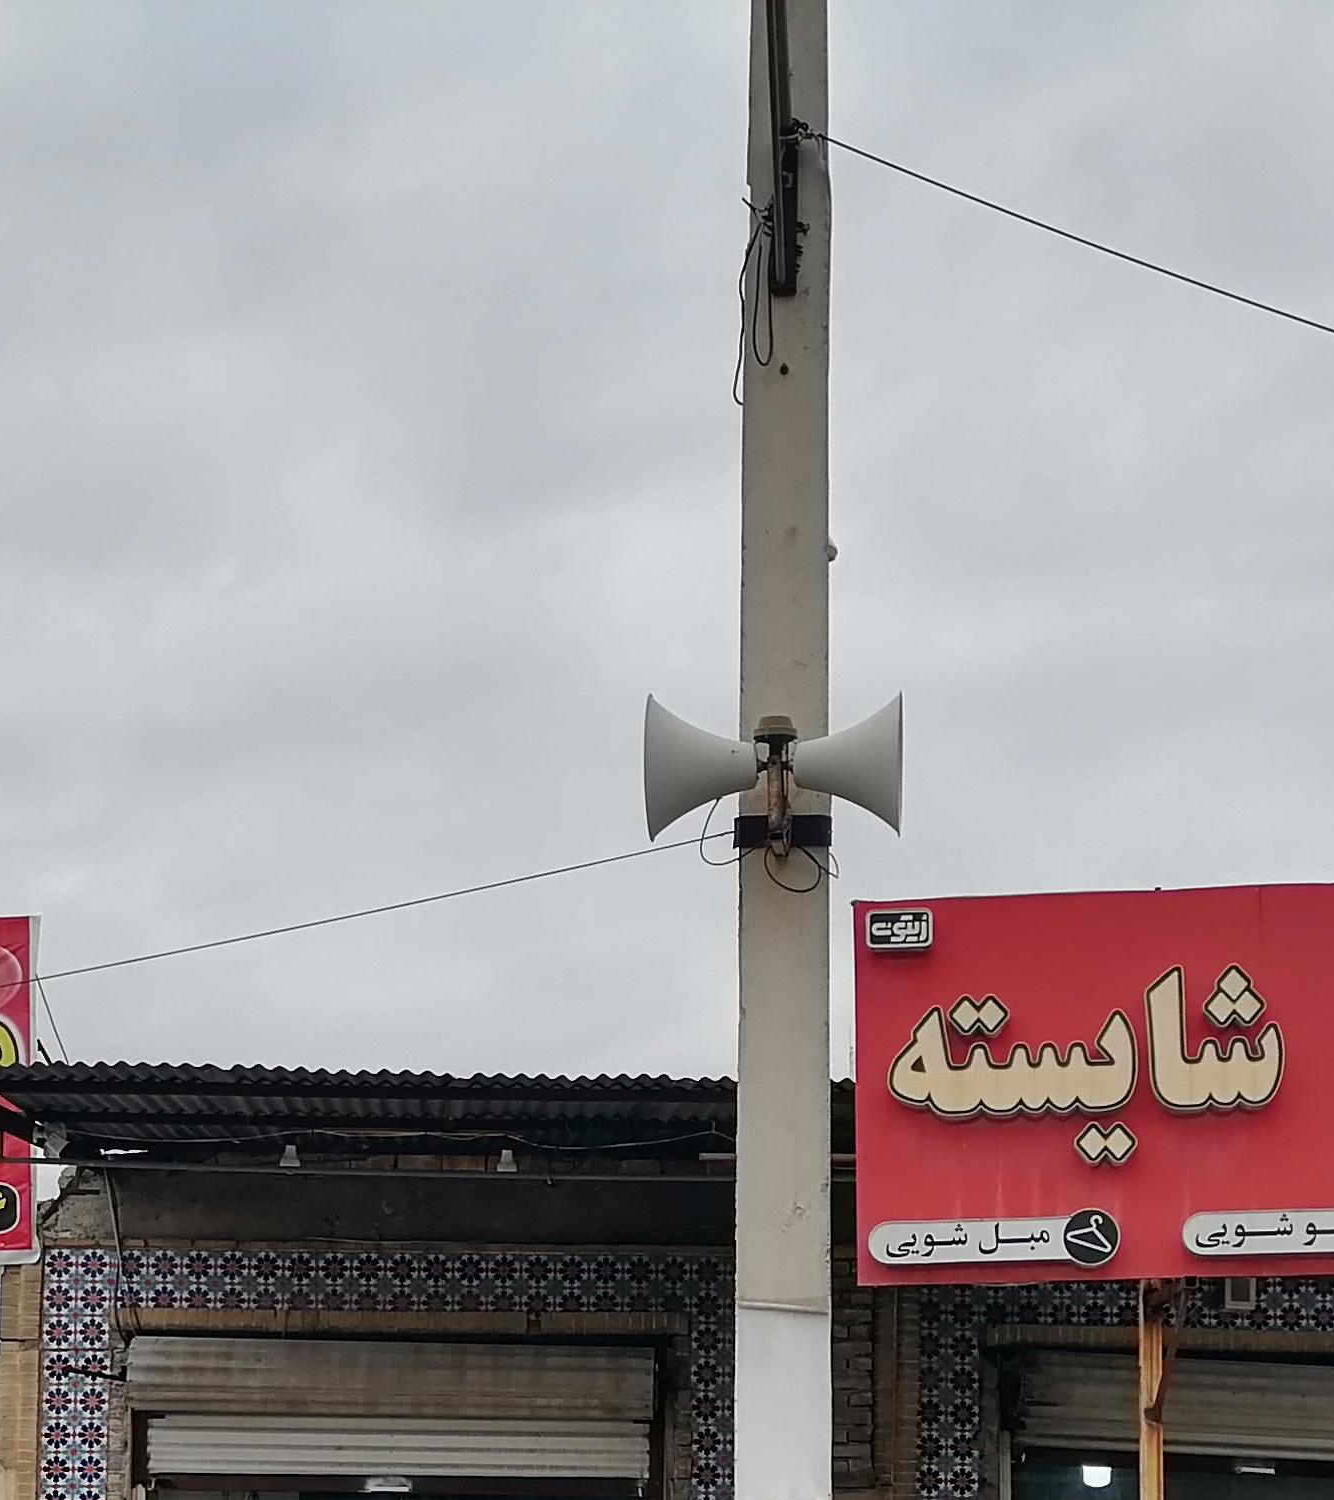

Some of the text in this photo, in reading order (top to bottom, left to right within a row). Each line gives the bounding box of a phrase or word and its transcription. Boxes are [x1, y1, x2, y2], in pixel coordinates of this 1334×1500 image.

[889, 964, 1284, 1164] شایسته
[886, 1222, 1050, 1258] مبل شویی
[1195, 1213, 1294, 1248] شویی
